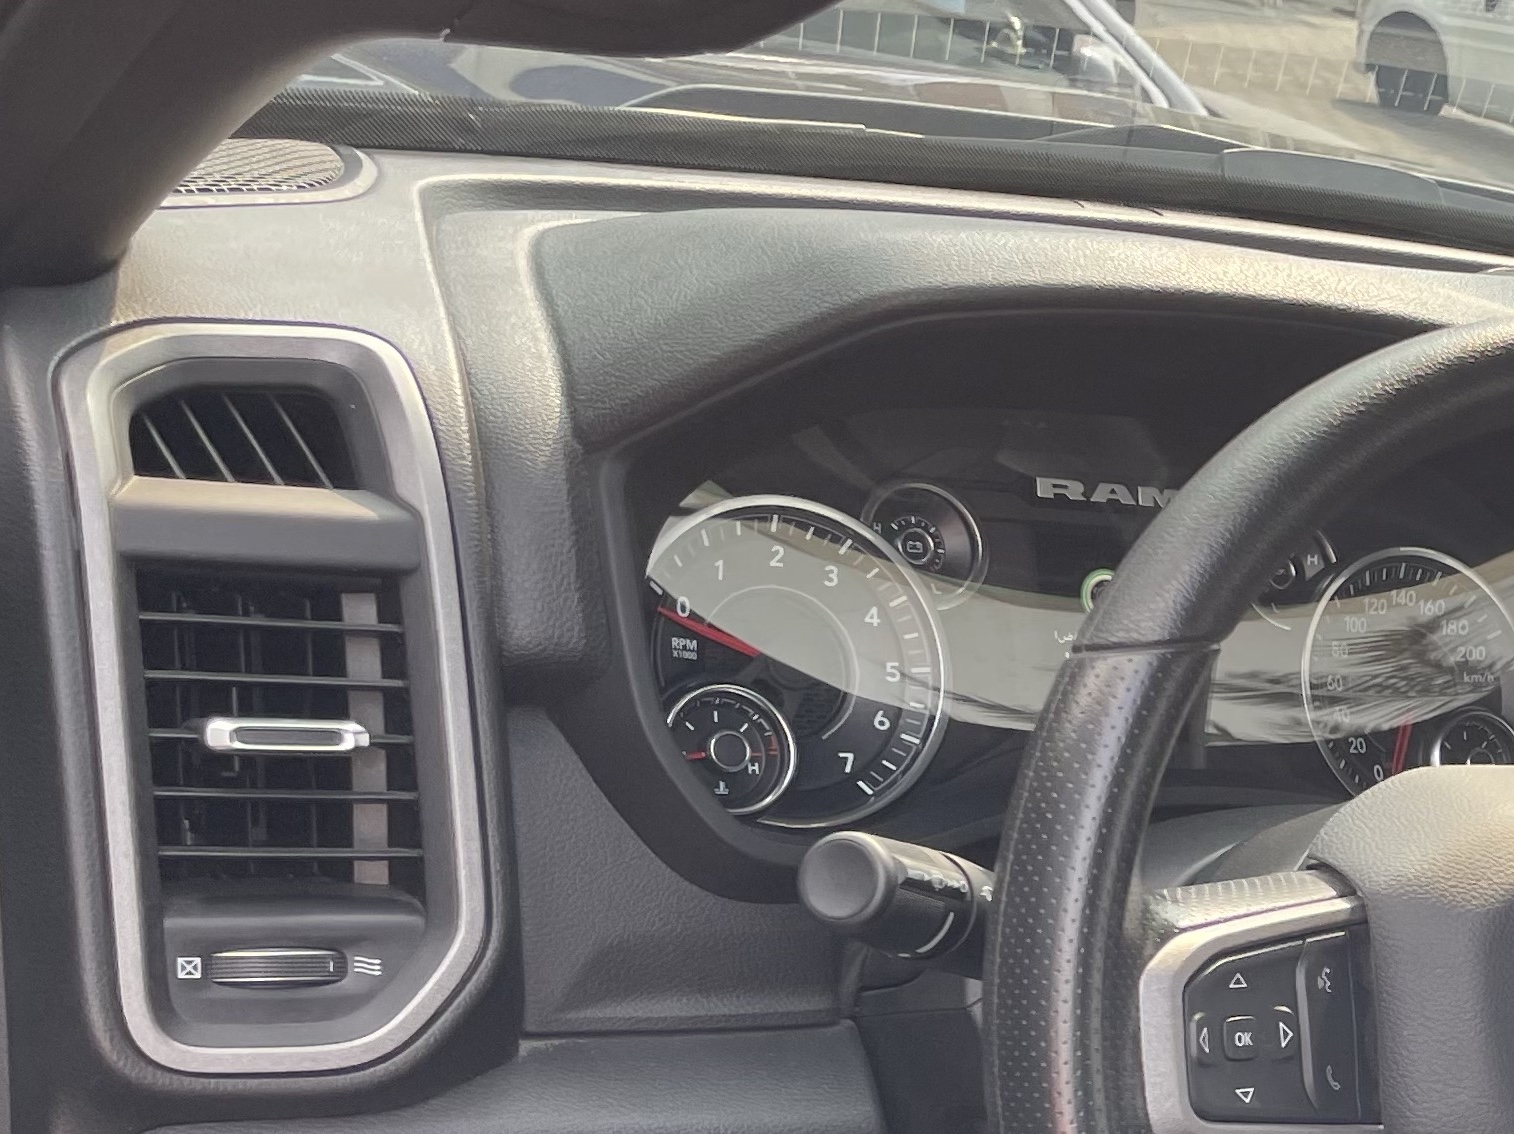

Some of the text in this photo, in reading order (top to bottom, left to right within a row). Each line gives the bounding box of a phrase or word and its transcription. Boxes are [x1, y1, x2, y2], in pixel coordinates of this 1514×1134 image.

[1035, 476, 1181, 509] RAM
[769, 546, 785, 568] 2
[1306, 553, 1318, 566] H
[714, 559, 725, 581] 1
[823, 565, 840, 587] 3
[675, 596, 691, 618] 0
[1364, 598, 1388, 615] 120
[1391, 590, 1416, 607] 140
[1419, 599, 1446, 616] 160
[864, 606, 881, 628] 4
[1344, 616, 1367, 633] 100
[1441, 618, 1470, 637] 180
[671, 636, 698, 651] RPM
[1456, 645, 1486, 663] 200
[885, 661, 901, 684] 5
[1326, 674, 1343, 693] 60
[873, 710, 891, 732] 6
[1333, 706, 1351, 725] 40
[1349, 736, 1367, 755] 20
[748, 762, 760, 775] H
[838, 752, 855, 774] 7
[1373, 764, 1384, 782] 0
[1235, 1031, 1253, 1047] OK
